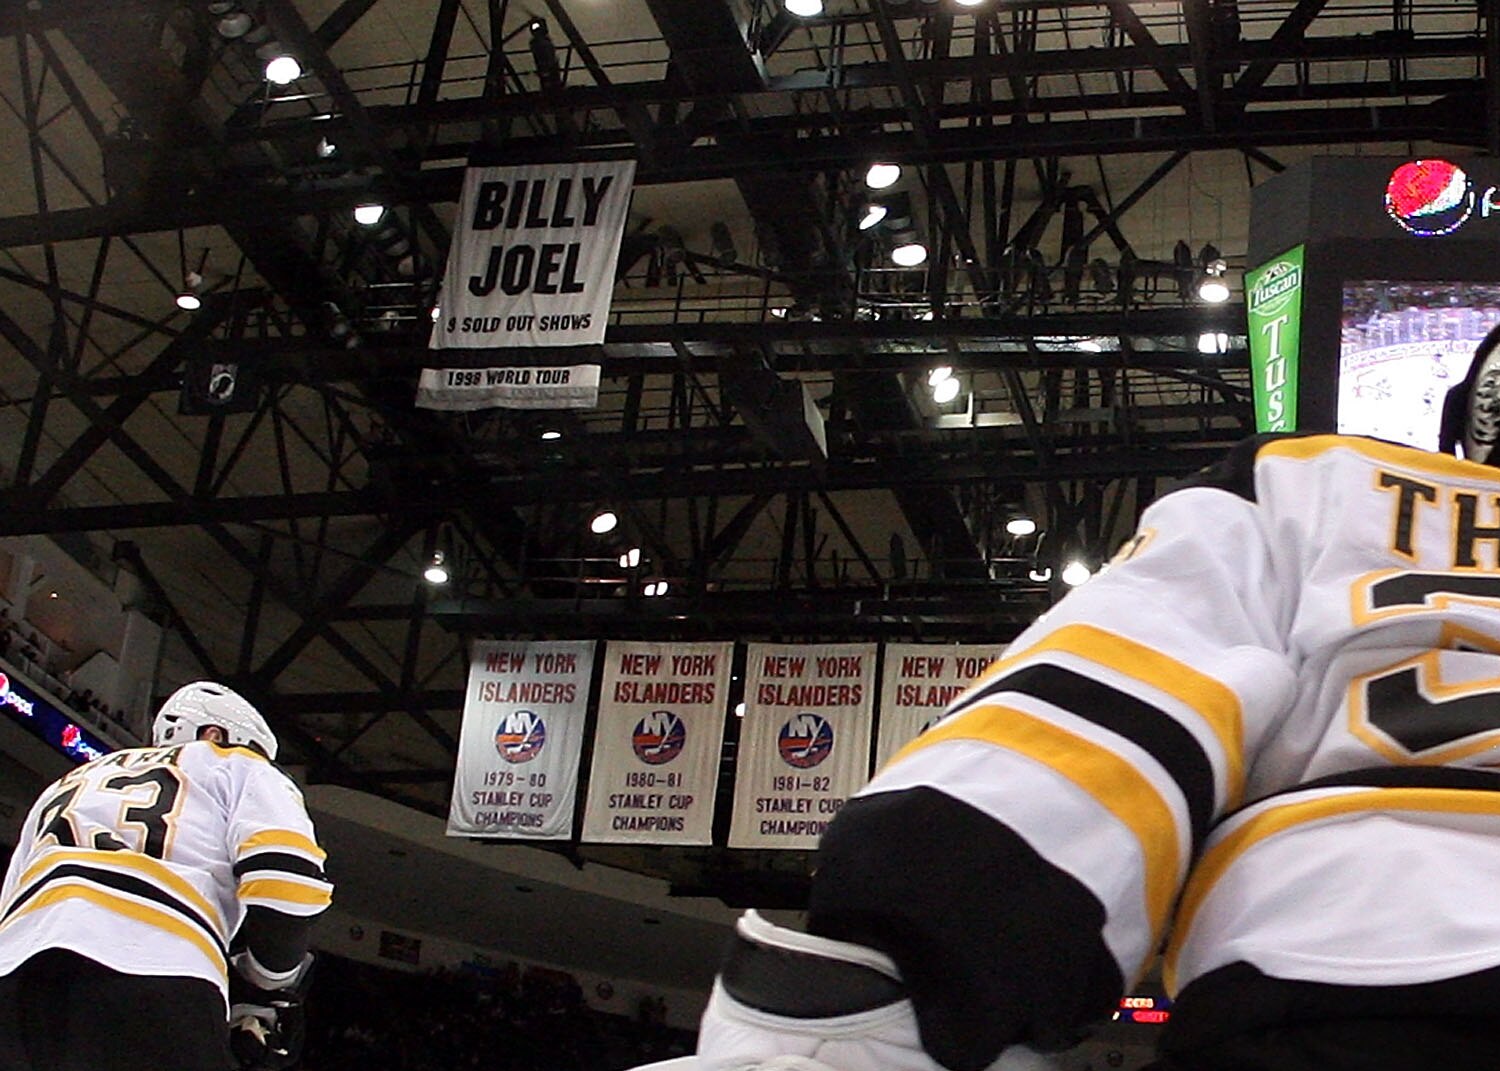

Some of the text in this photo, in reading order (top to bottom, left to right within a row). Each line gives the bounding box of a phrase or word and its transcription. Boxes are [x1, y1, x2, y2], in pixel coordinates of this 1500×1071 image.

[472, 176, 613, 230] BILLY
[468, 243, 584, 296] JOEL
[1252, 273, 1298, 307] Tuscan
[462, 316, 500, 333] SOLD
[506, 316, 535, 332] OUT
[540, 314, 591, 330] SHOWS
[448, 370, 570, 386] 1998 WORLD TOUR
[485, 653, 577, 673] NEW YORK
[620, 654, 717, 677] NEW YORK
[763, 656, 862, 678] NEW YORK
[901, 656, 945, 678] NEW
[478, 682, 577, 704] ISLANDERS
[614, 682, 715, 704] ISLANDERS
[757, 684, 862, 706] ISLANDERS
[773, 776, 830, 791] 1981-82
[472, 792, 553, 808] STANLEY CUP
[608, 794, 694, 810] STANLEY CUP
[756, 798, 813, 813] STANLEY
[475, 811, 544, 828] CHAMPIONS
[612, 816, 684, 832] CHAMPIONS
